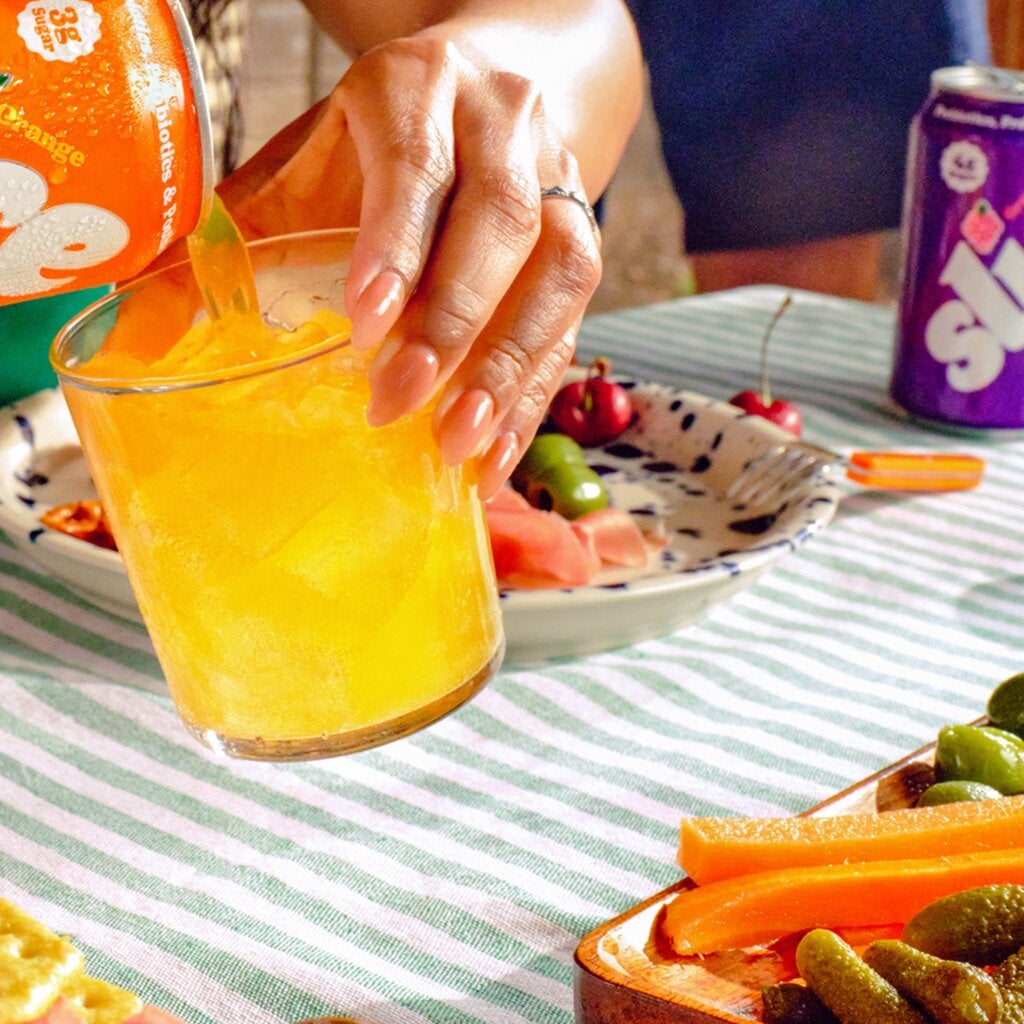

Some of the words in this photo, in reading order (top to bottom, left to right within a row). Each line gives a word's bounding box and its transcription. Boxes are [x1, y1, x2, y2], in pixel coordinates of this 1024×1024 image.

[32, 7, 55, 52] Sugar
[49, 7, 81, 44] 3g
[145, 63, 176, 183] Pobiotics
[162, 185, 177, 206] &
